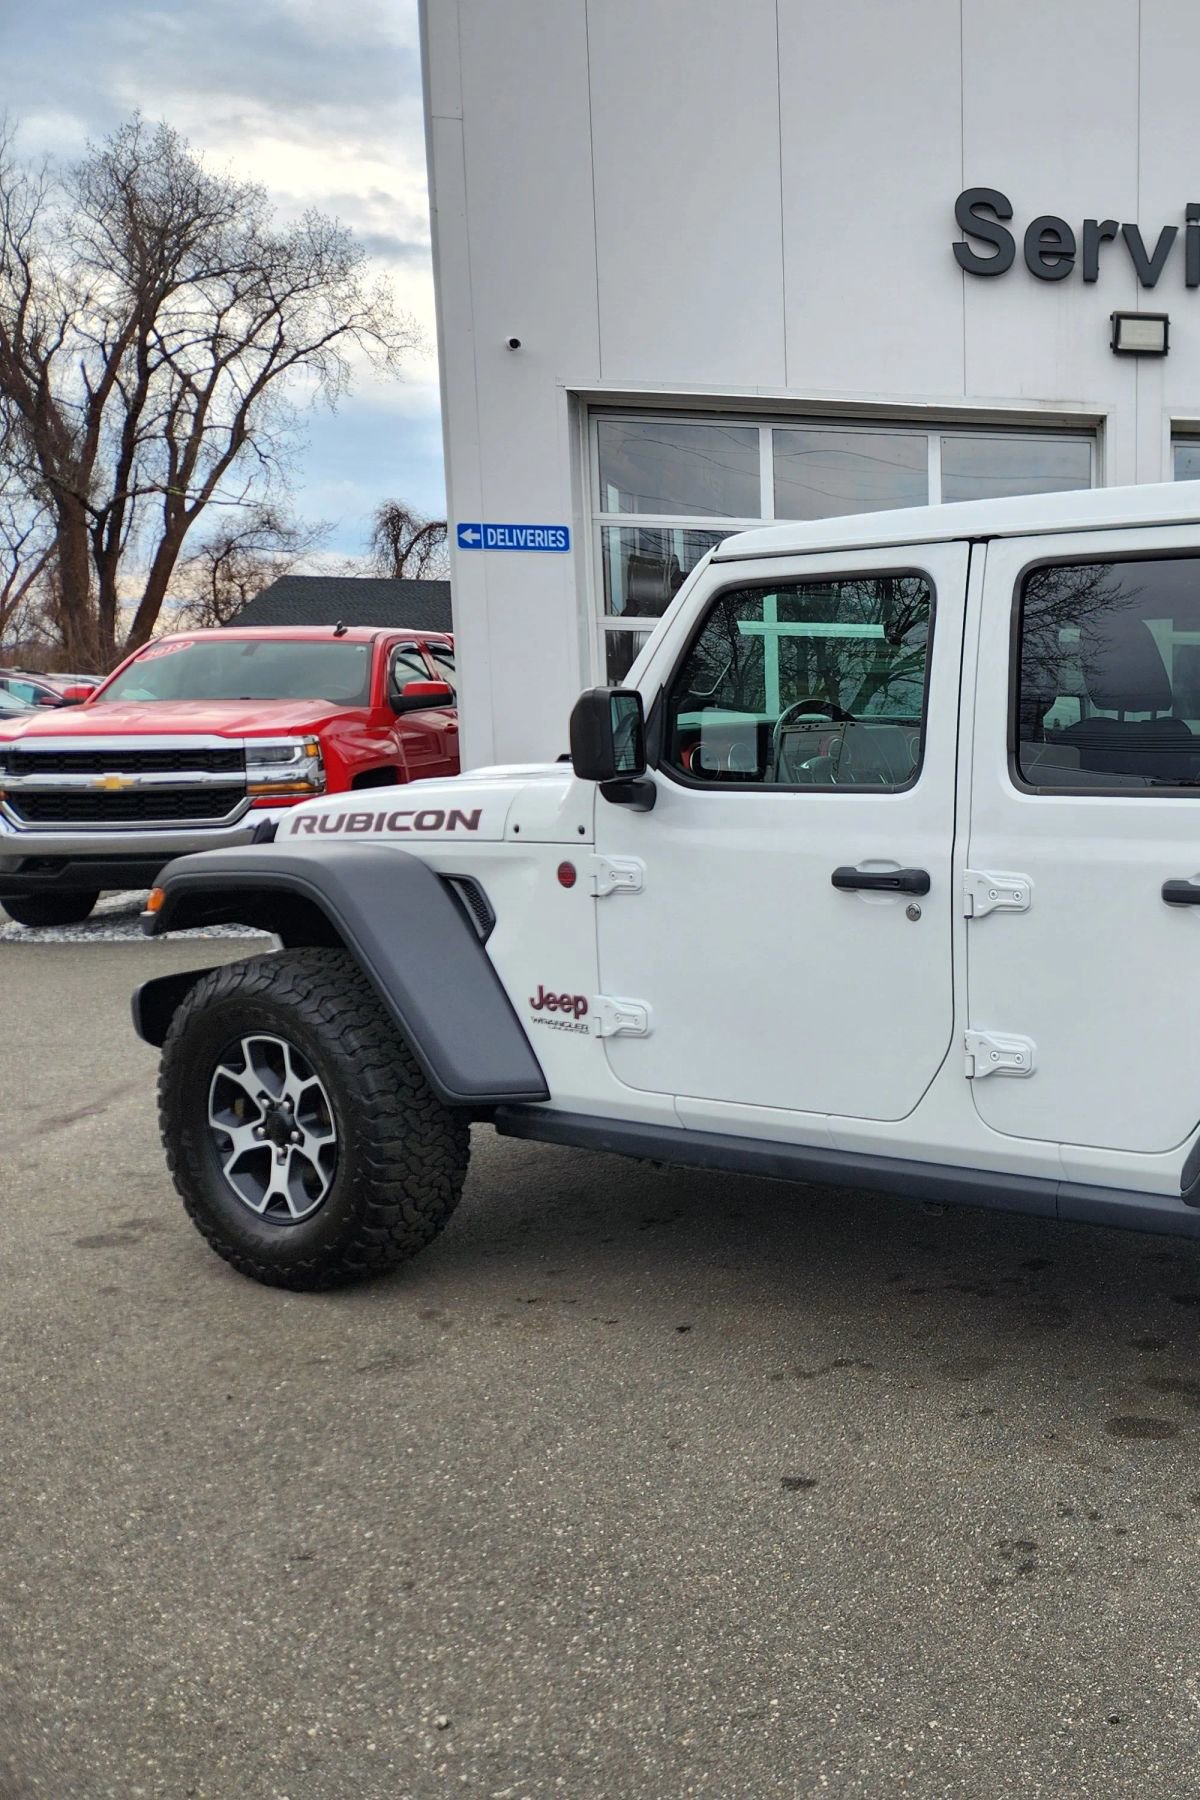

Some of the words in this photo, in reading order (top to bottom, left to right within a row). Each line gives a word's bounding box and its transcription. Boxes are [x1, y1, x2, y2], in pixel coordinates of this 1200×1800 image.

[487, 528, 566, 547] DELIVERIES
[290, 809, 482, 834] RUBICON
[529, 985, 588, 1019] Jeep
